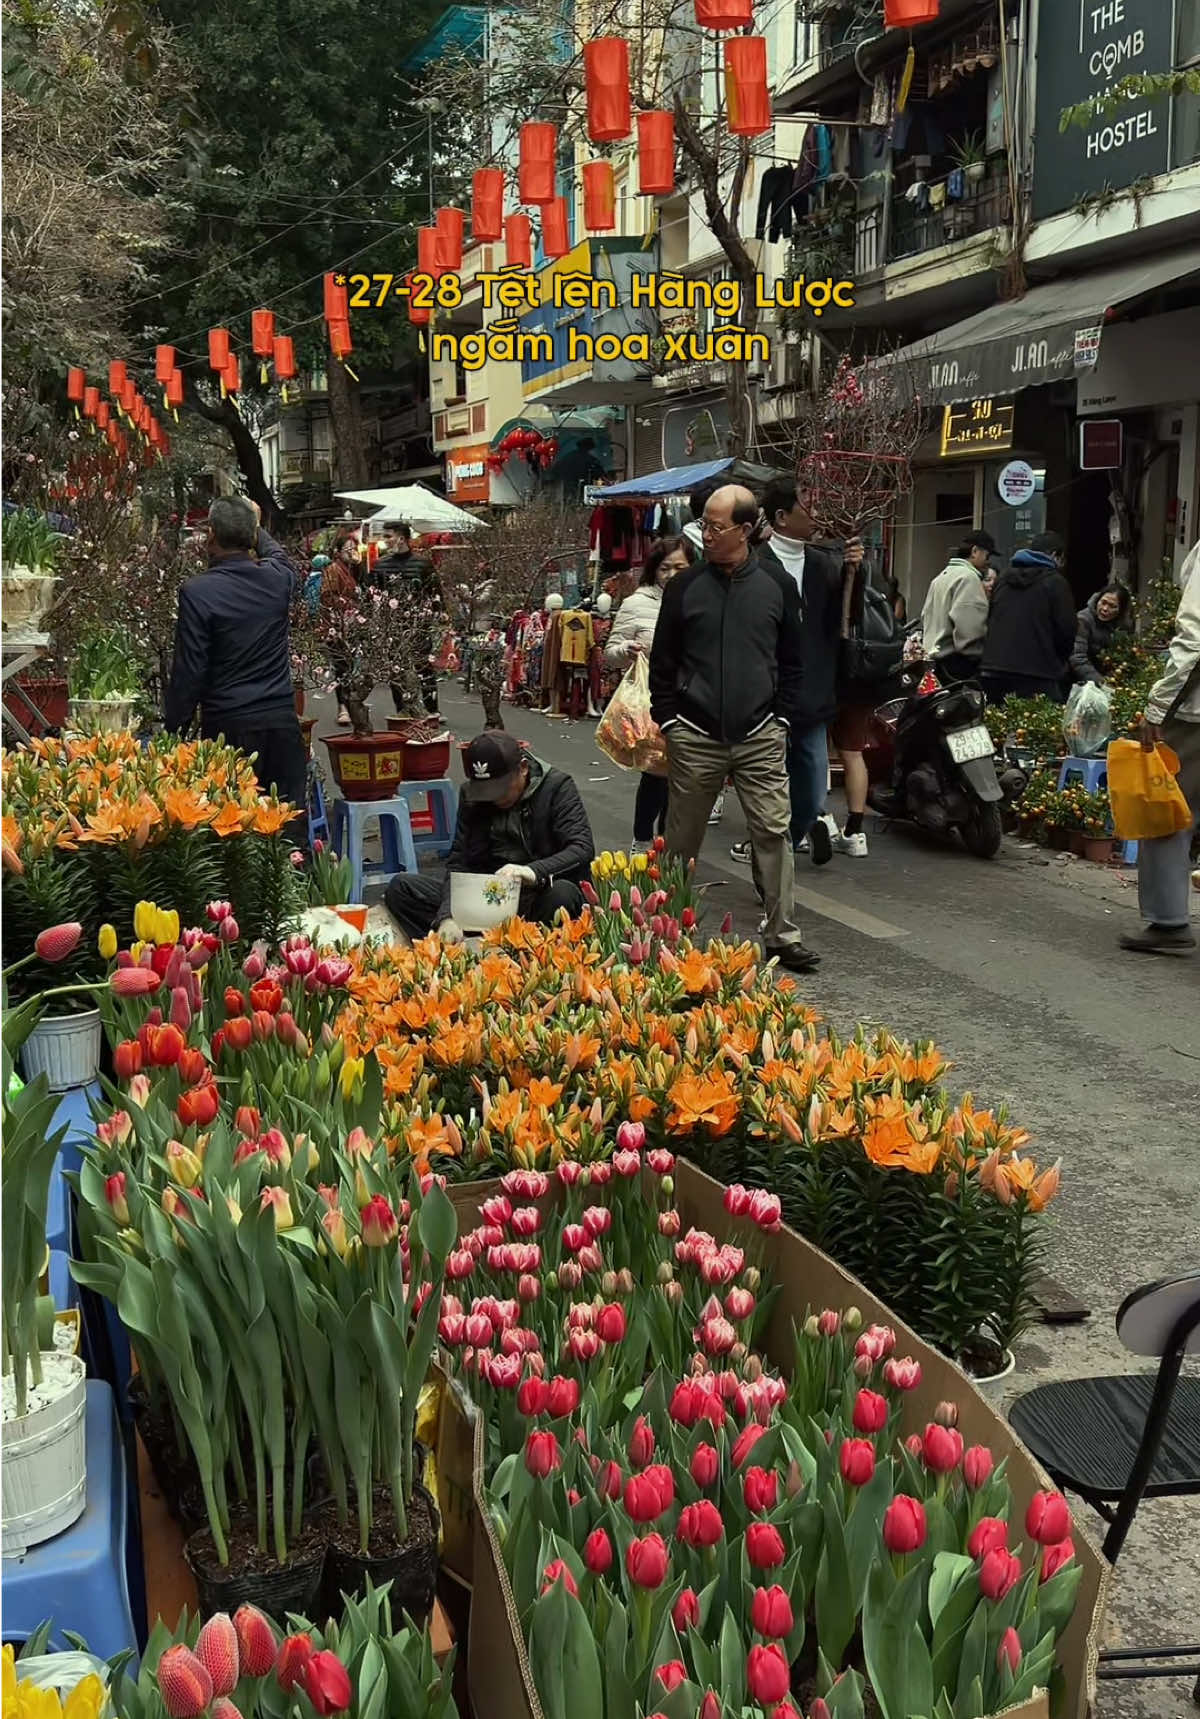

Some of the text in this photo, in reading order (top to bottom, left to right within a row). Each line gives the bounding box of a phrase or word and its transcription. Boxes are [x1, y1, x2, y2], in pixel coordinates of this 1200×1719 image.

[1091, 0, 1125, 34] THE
[1089, 29, 1145, 78] COMB
[1086, 109, 1157, 159] HOSTEL
